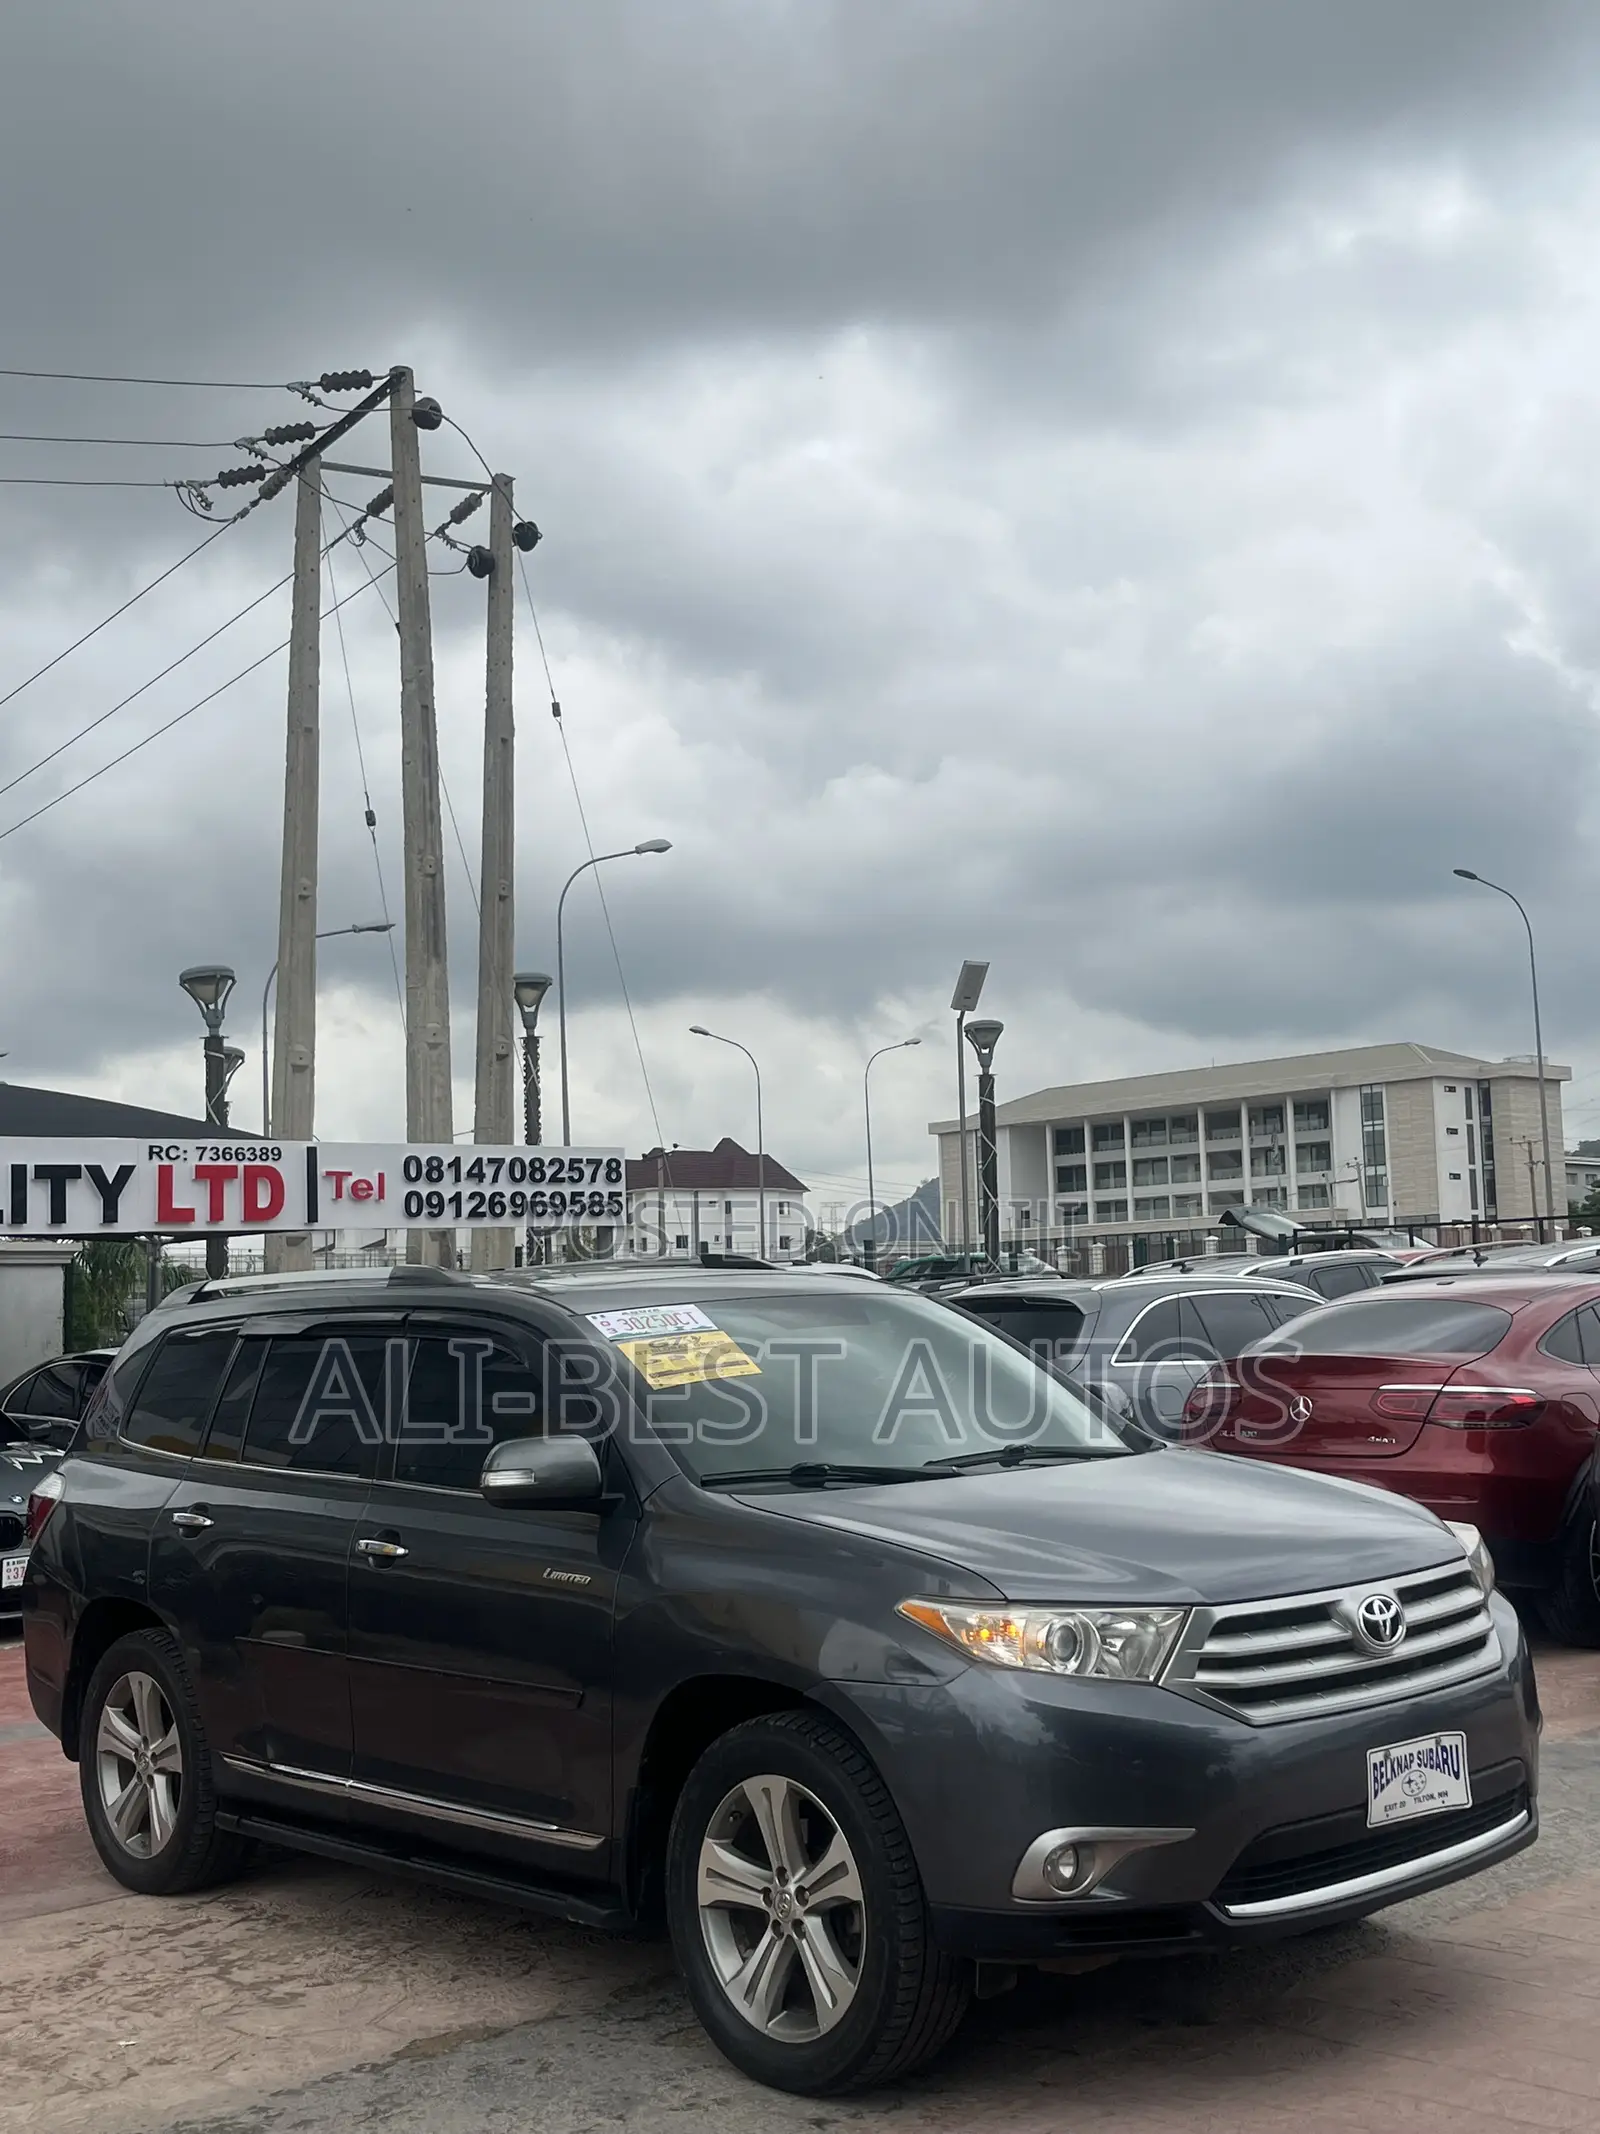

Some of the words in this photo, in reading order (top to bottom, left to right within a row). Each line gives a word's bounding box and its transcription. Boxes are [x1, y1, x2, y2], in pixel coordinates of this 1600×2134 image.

[148, 1145, 188, 1161] RC:
[195, 1146, 282, 1162] 7366389
[403, 1155, 623, 1184] 08147082578
[0, 1164, 137, 1224] ITY
[156, 1164, 285, 1223] LTD
[323, 1171, 385, 1201] Tel
[403, 1190, 624, 1218] 09126969585
[1373, 1752, 1415, 1799] BELKNAP
[1416, 1744, 1460, 1780] SUBARU
[1384, 1802, 1398, 1812] EXIT
